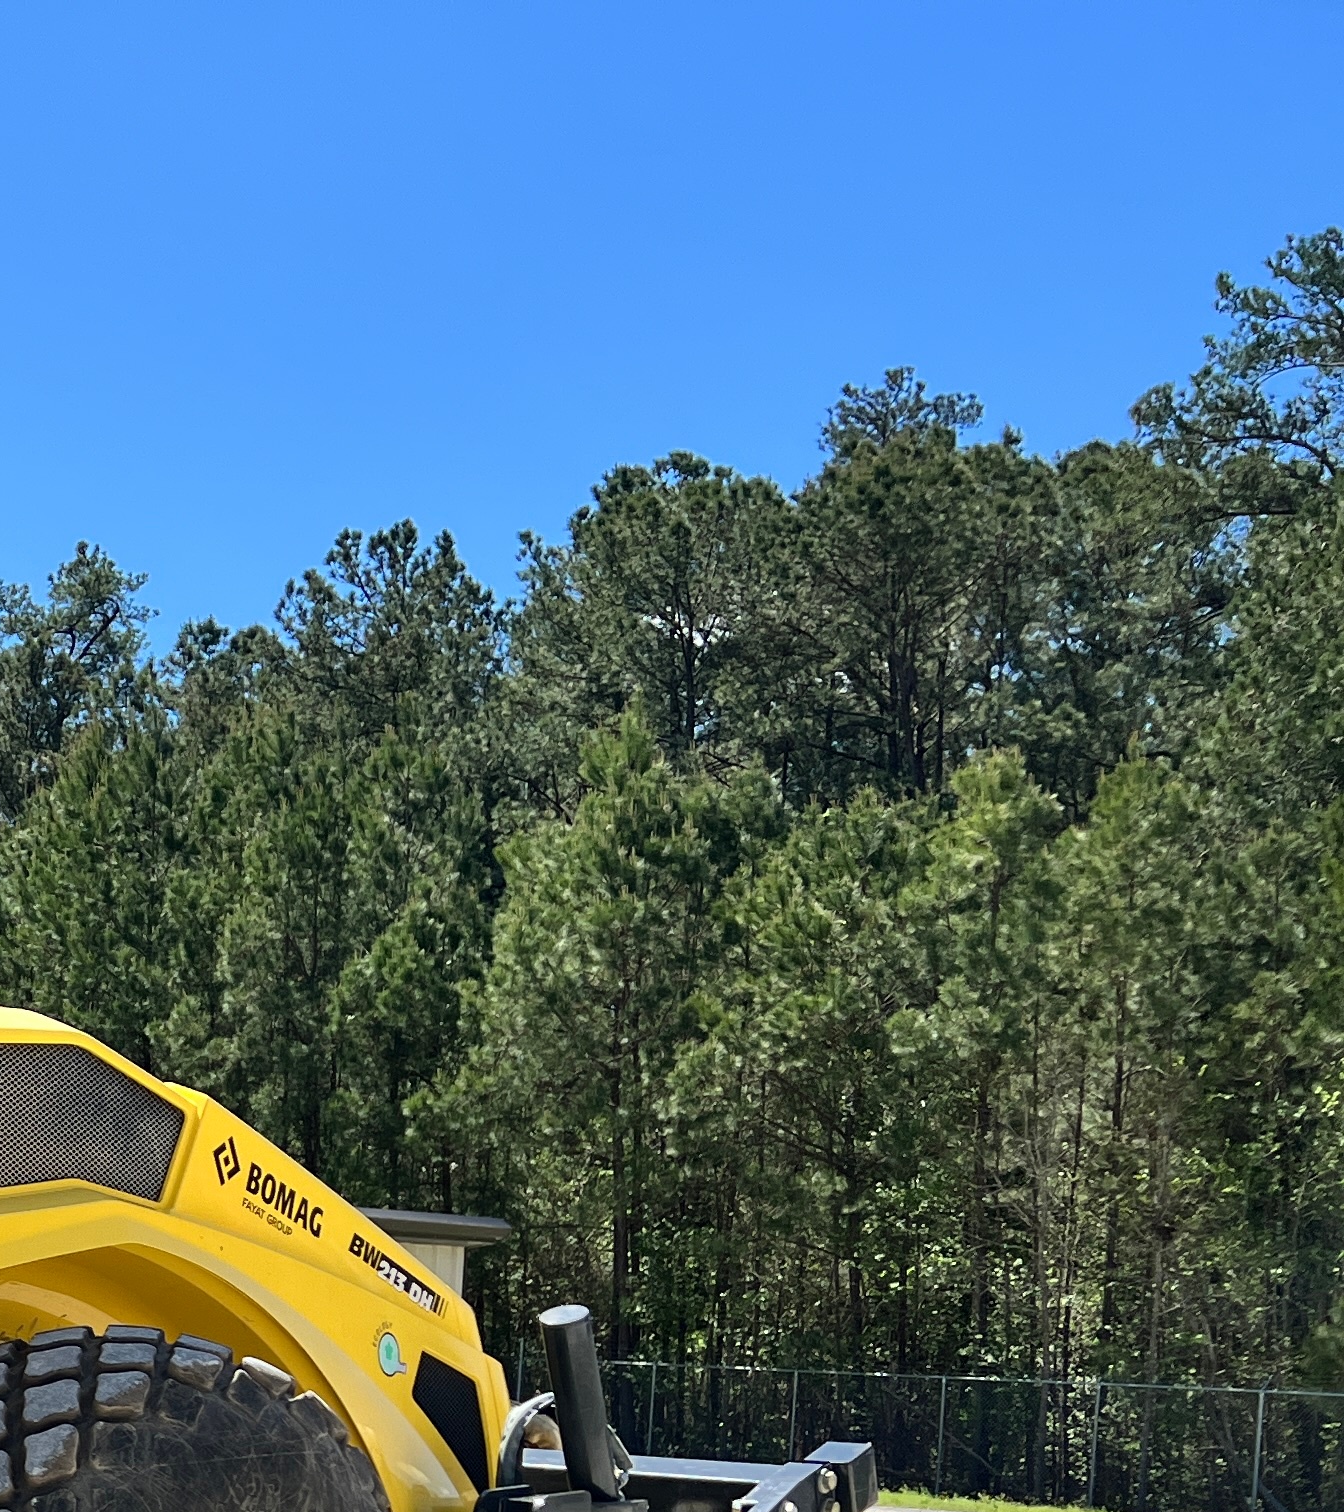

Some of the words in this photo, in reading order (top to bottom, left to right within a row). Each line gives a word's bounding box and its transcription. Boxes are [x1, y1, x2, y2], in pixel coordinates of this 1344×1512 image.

[242, 1197, 266, 1220] FAYAT
[266, 1213, 293, 1236] GROUP
[245, 1161, 324, 1238] BOMAG
